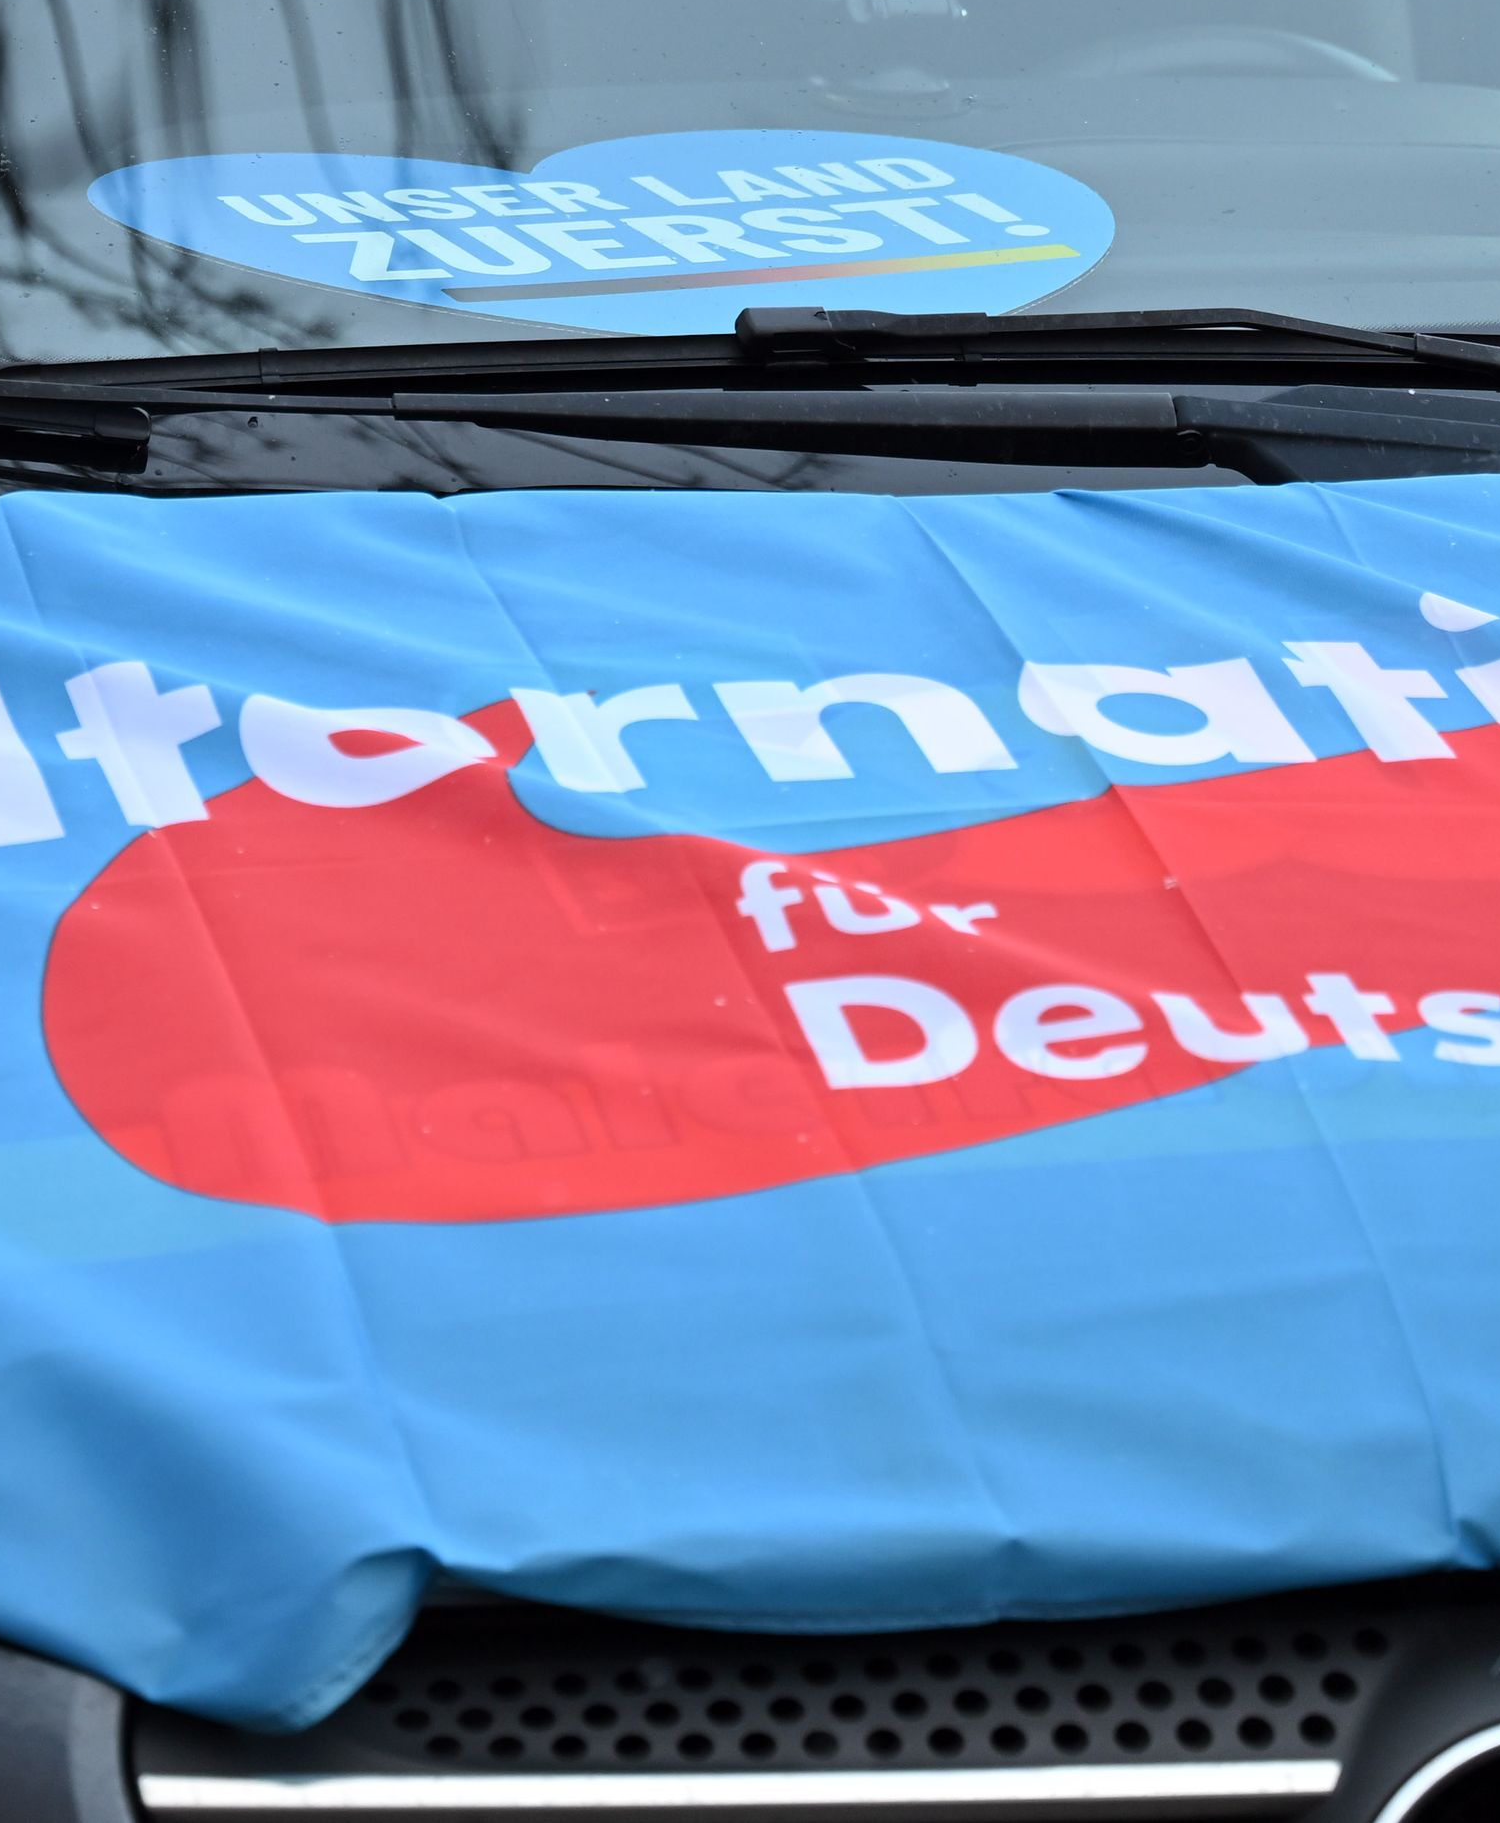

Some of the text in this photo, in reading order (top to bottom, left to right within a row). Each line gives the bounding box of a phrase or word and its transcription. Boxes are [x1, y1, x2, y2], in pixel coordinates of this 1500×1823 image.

[216, 156, 957, 227] UNSER LAND
[292, 193, 1051, 282] ZUERST!
[737, 859, 1002, 953] für
